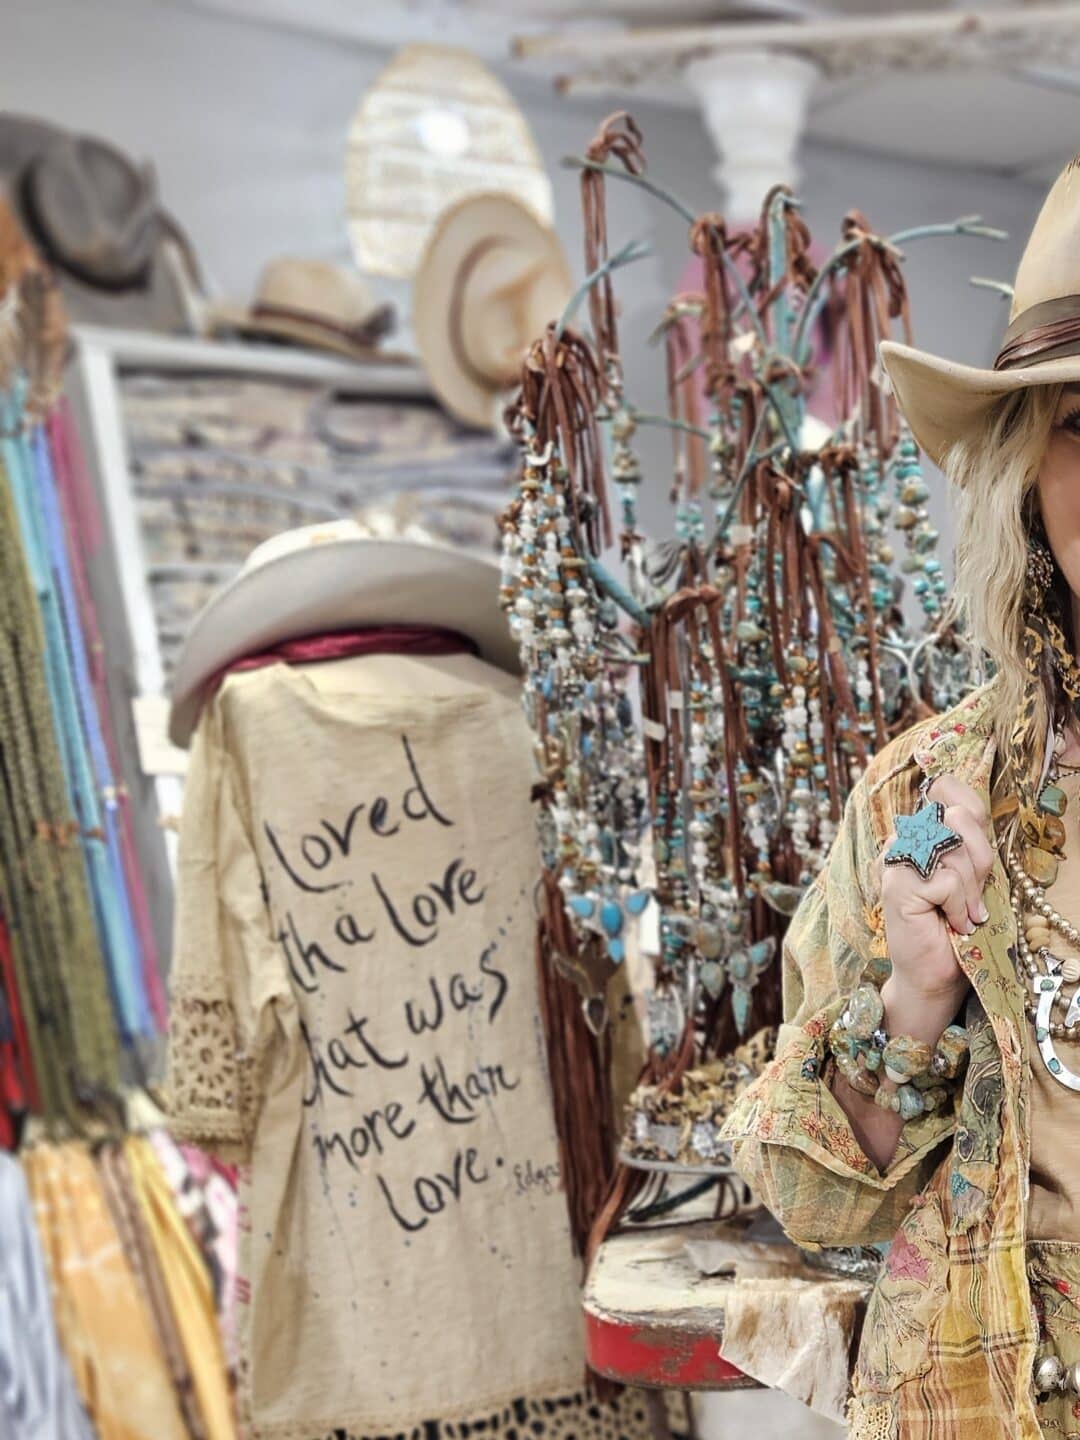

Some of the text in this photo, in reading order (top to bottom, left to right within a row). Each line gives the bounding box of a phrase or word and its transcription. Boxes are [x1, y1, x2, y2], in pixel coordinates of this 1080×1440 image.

[334, 913, 376, 945] a
[404, 948, 508, 1036] was
[313, 1055, 520, 1172] more than
